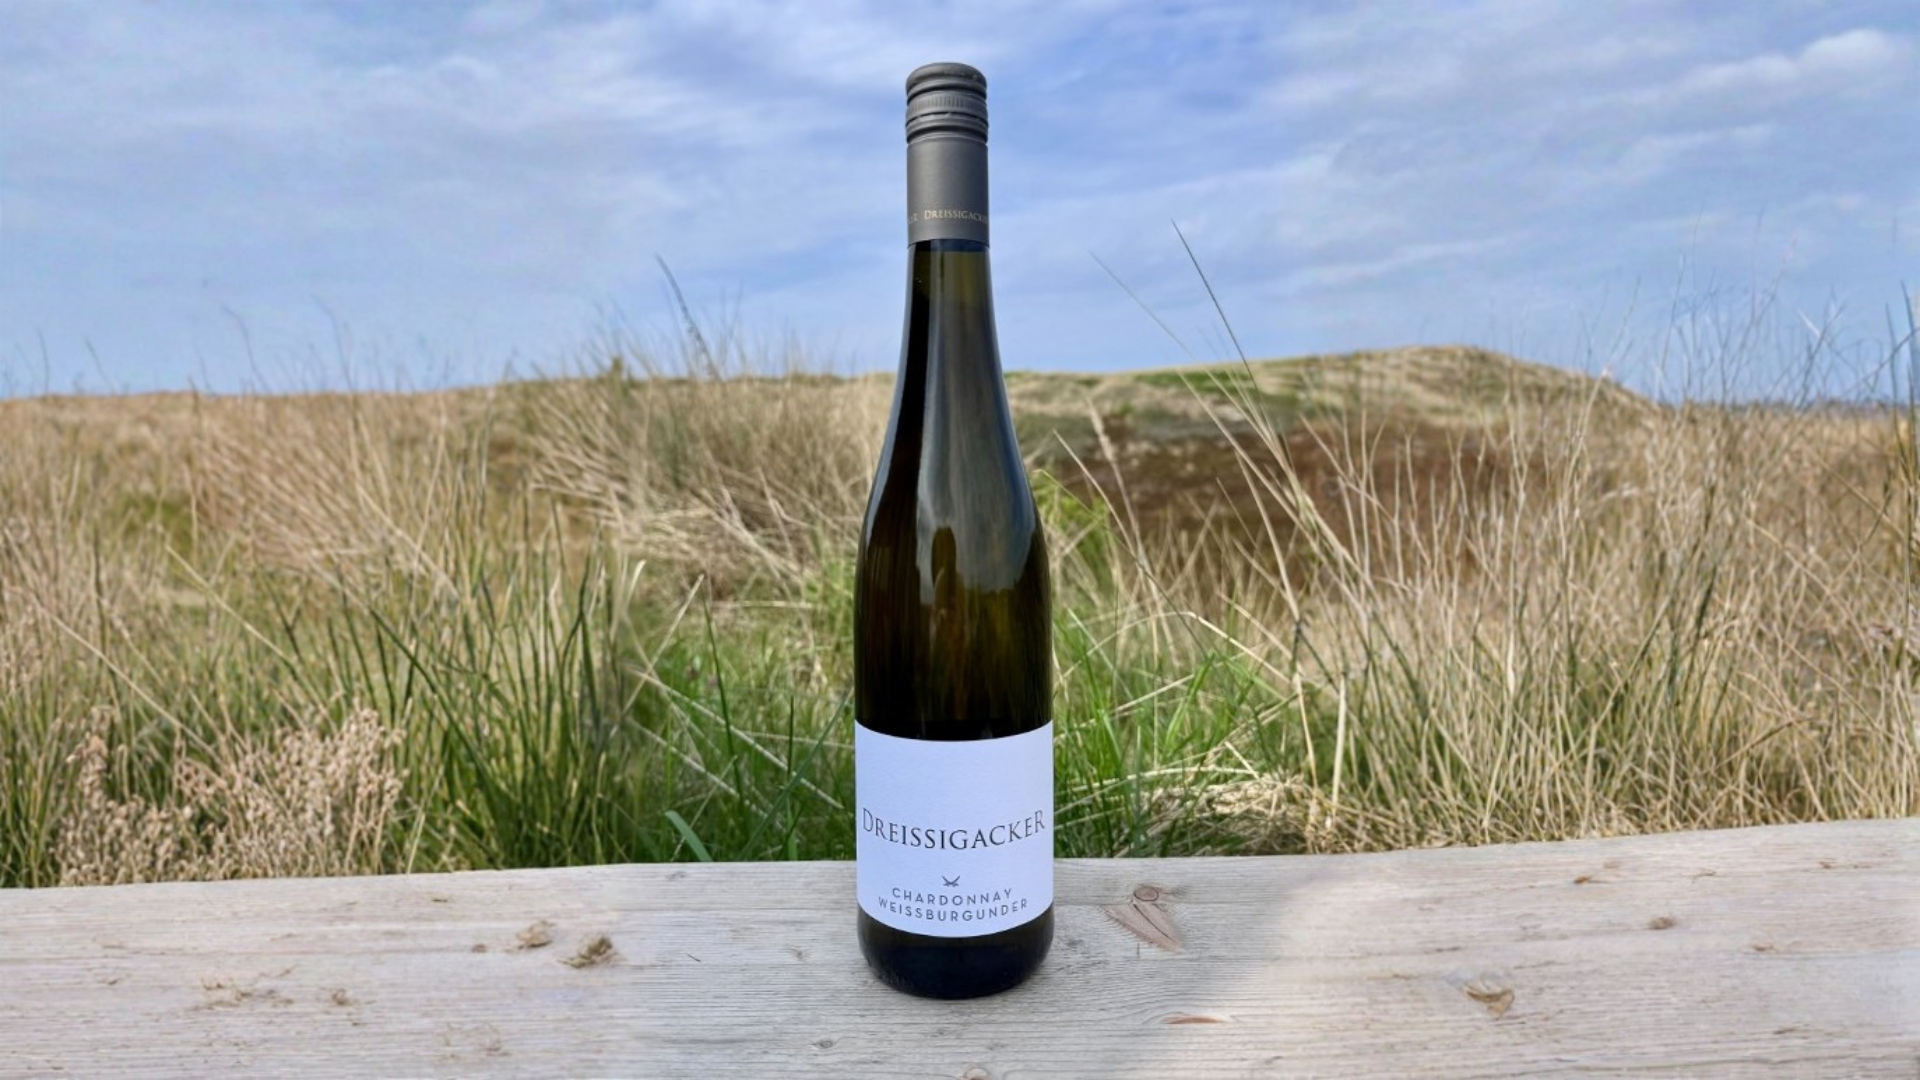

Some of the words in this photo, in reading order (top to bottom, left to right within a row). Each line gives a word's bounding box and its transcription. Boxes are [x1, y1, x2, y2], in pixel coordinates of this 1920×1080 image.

[863, 807, 1045, 850] DREISSIGACKER
[878, 896, 1027, 922] WEISSBURGUNDER
[892, 887, 1012, 906] CHARDONNAY
